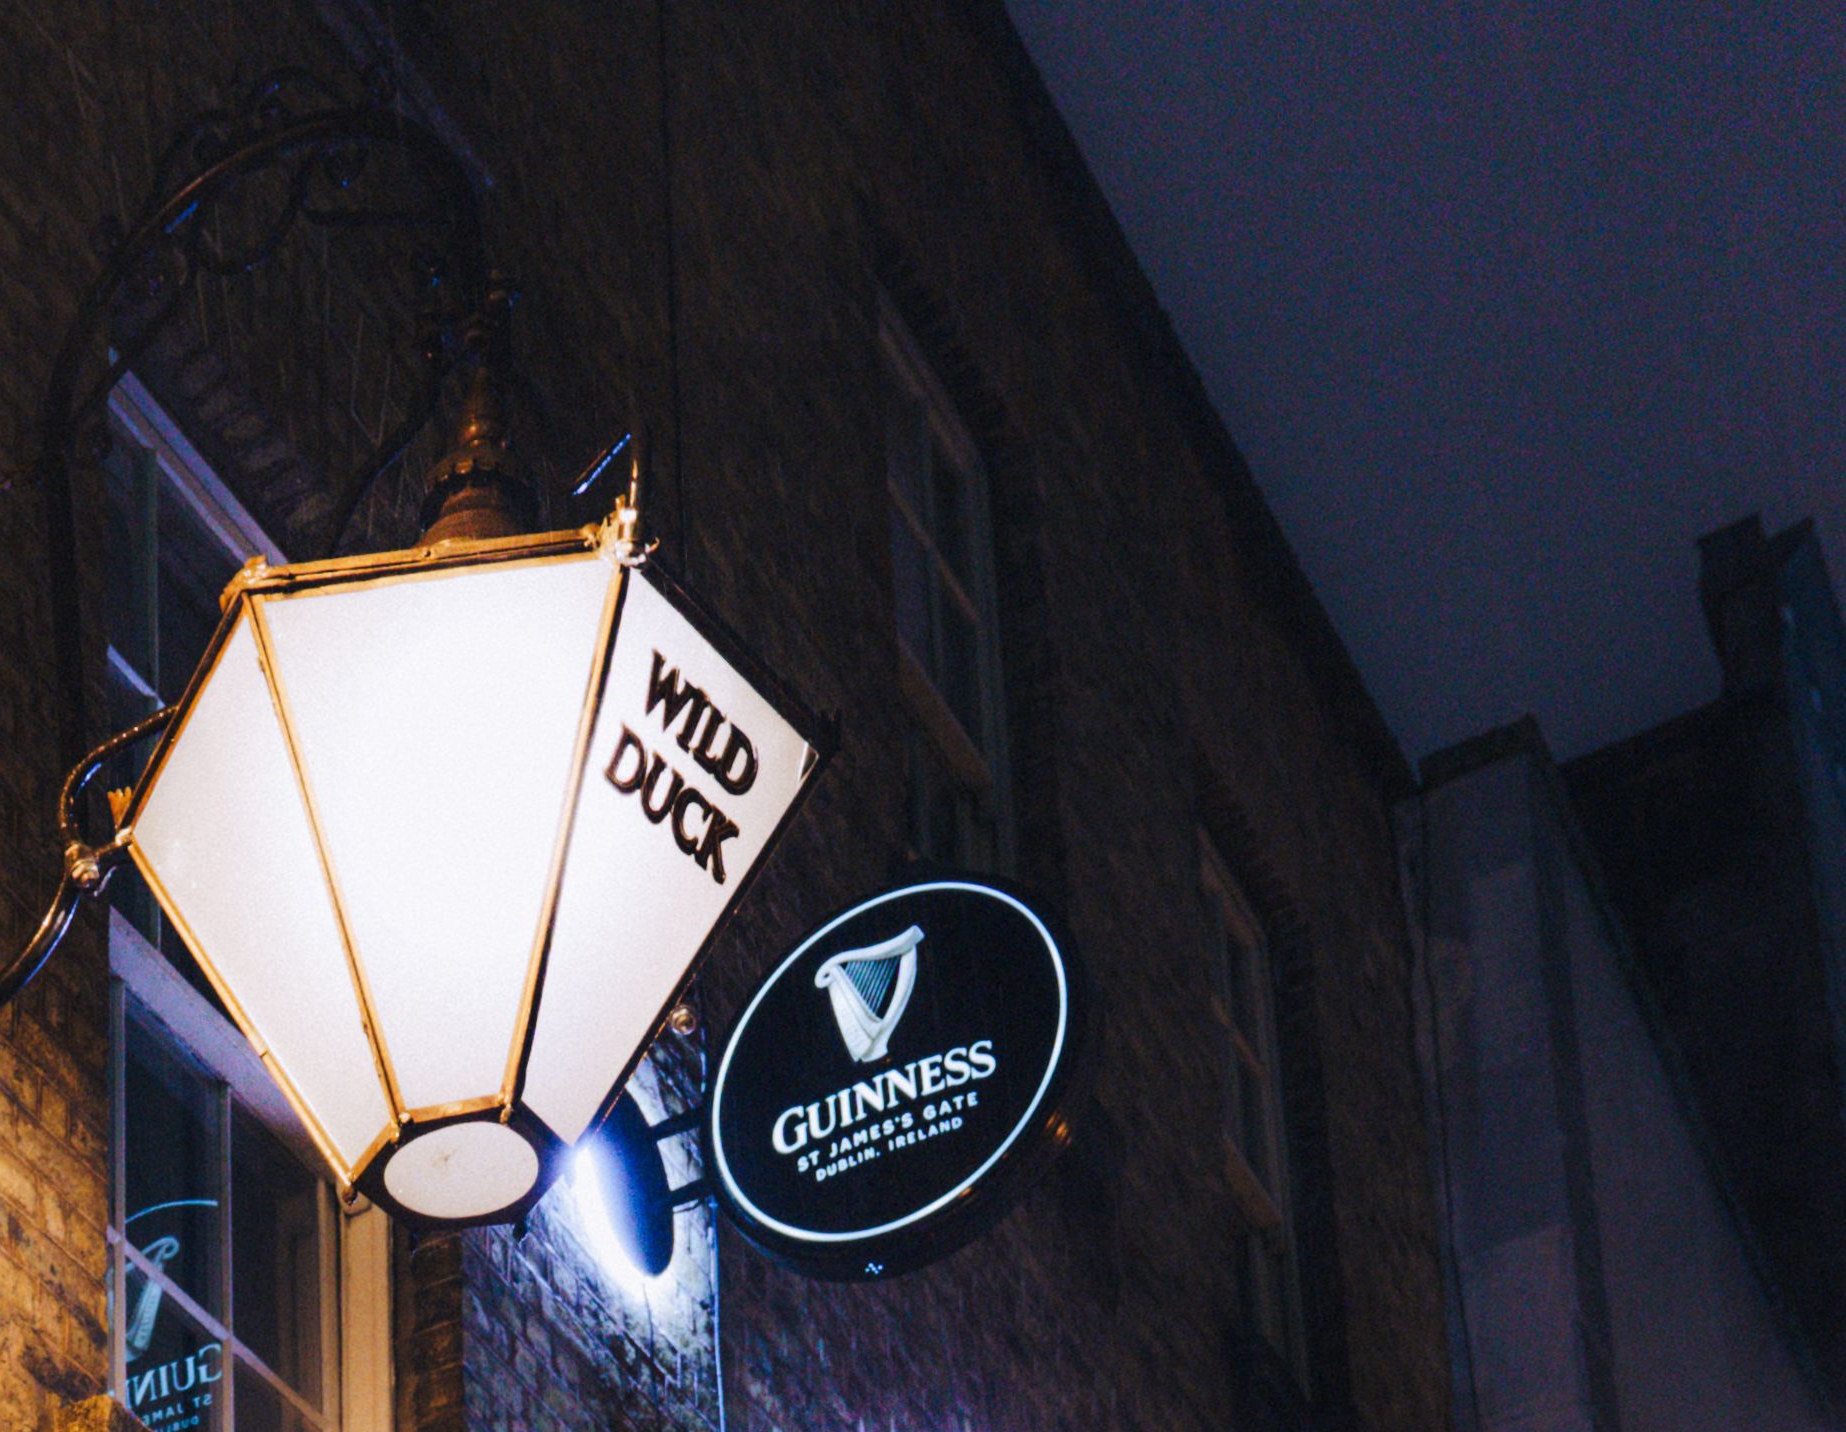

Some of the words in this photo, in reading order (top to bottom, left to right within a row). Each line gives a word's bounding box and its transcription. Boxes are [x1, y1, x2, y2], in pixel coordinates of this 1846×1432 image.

[646, 647, 759, 795] WILD
[604, 721, 740, 885] DUCK
[771, 1040, 998, 1155] GUINNESS
[797, 1150, 820, 1174] ST
[829, 1113, 914, 1160] JAMES'S
[922, 1091, 979, 1122] GATE
[889, 1117, 964, 1151] IRELAND
